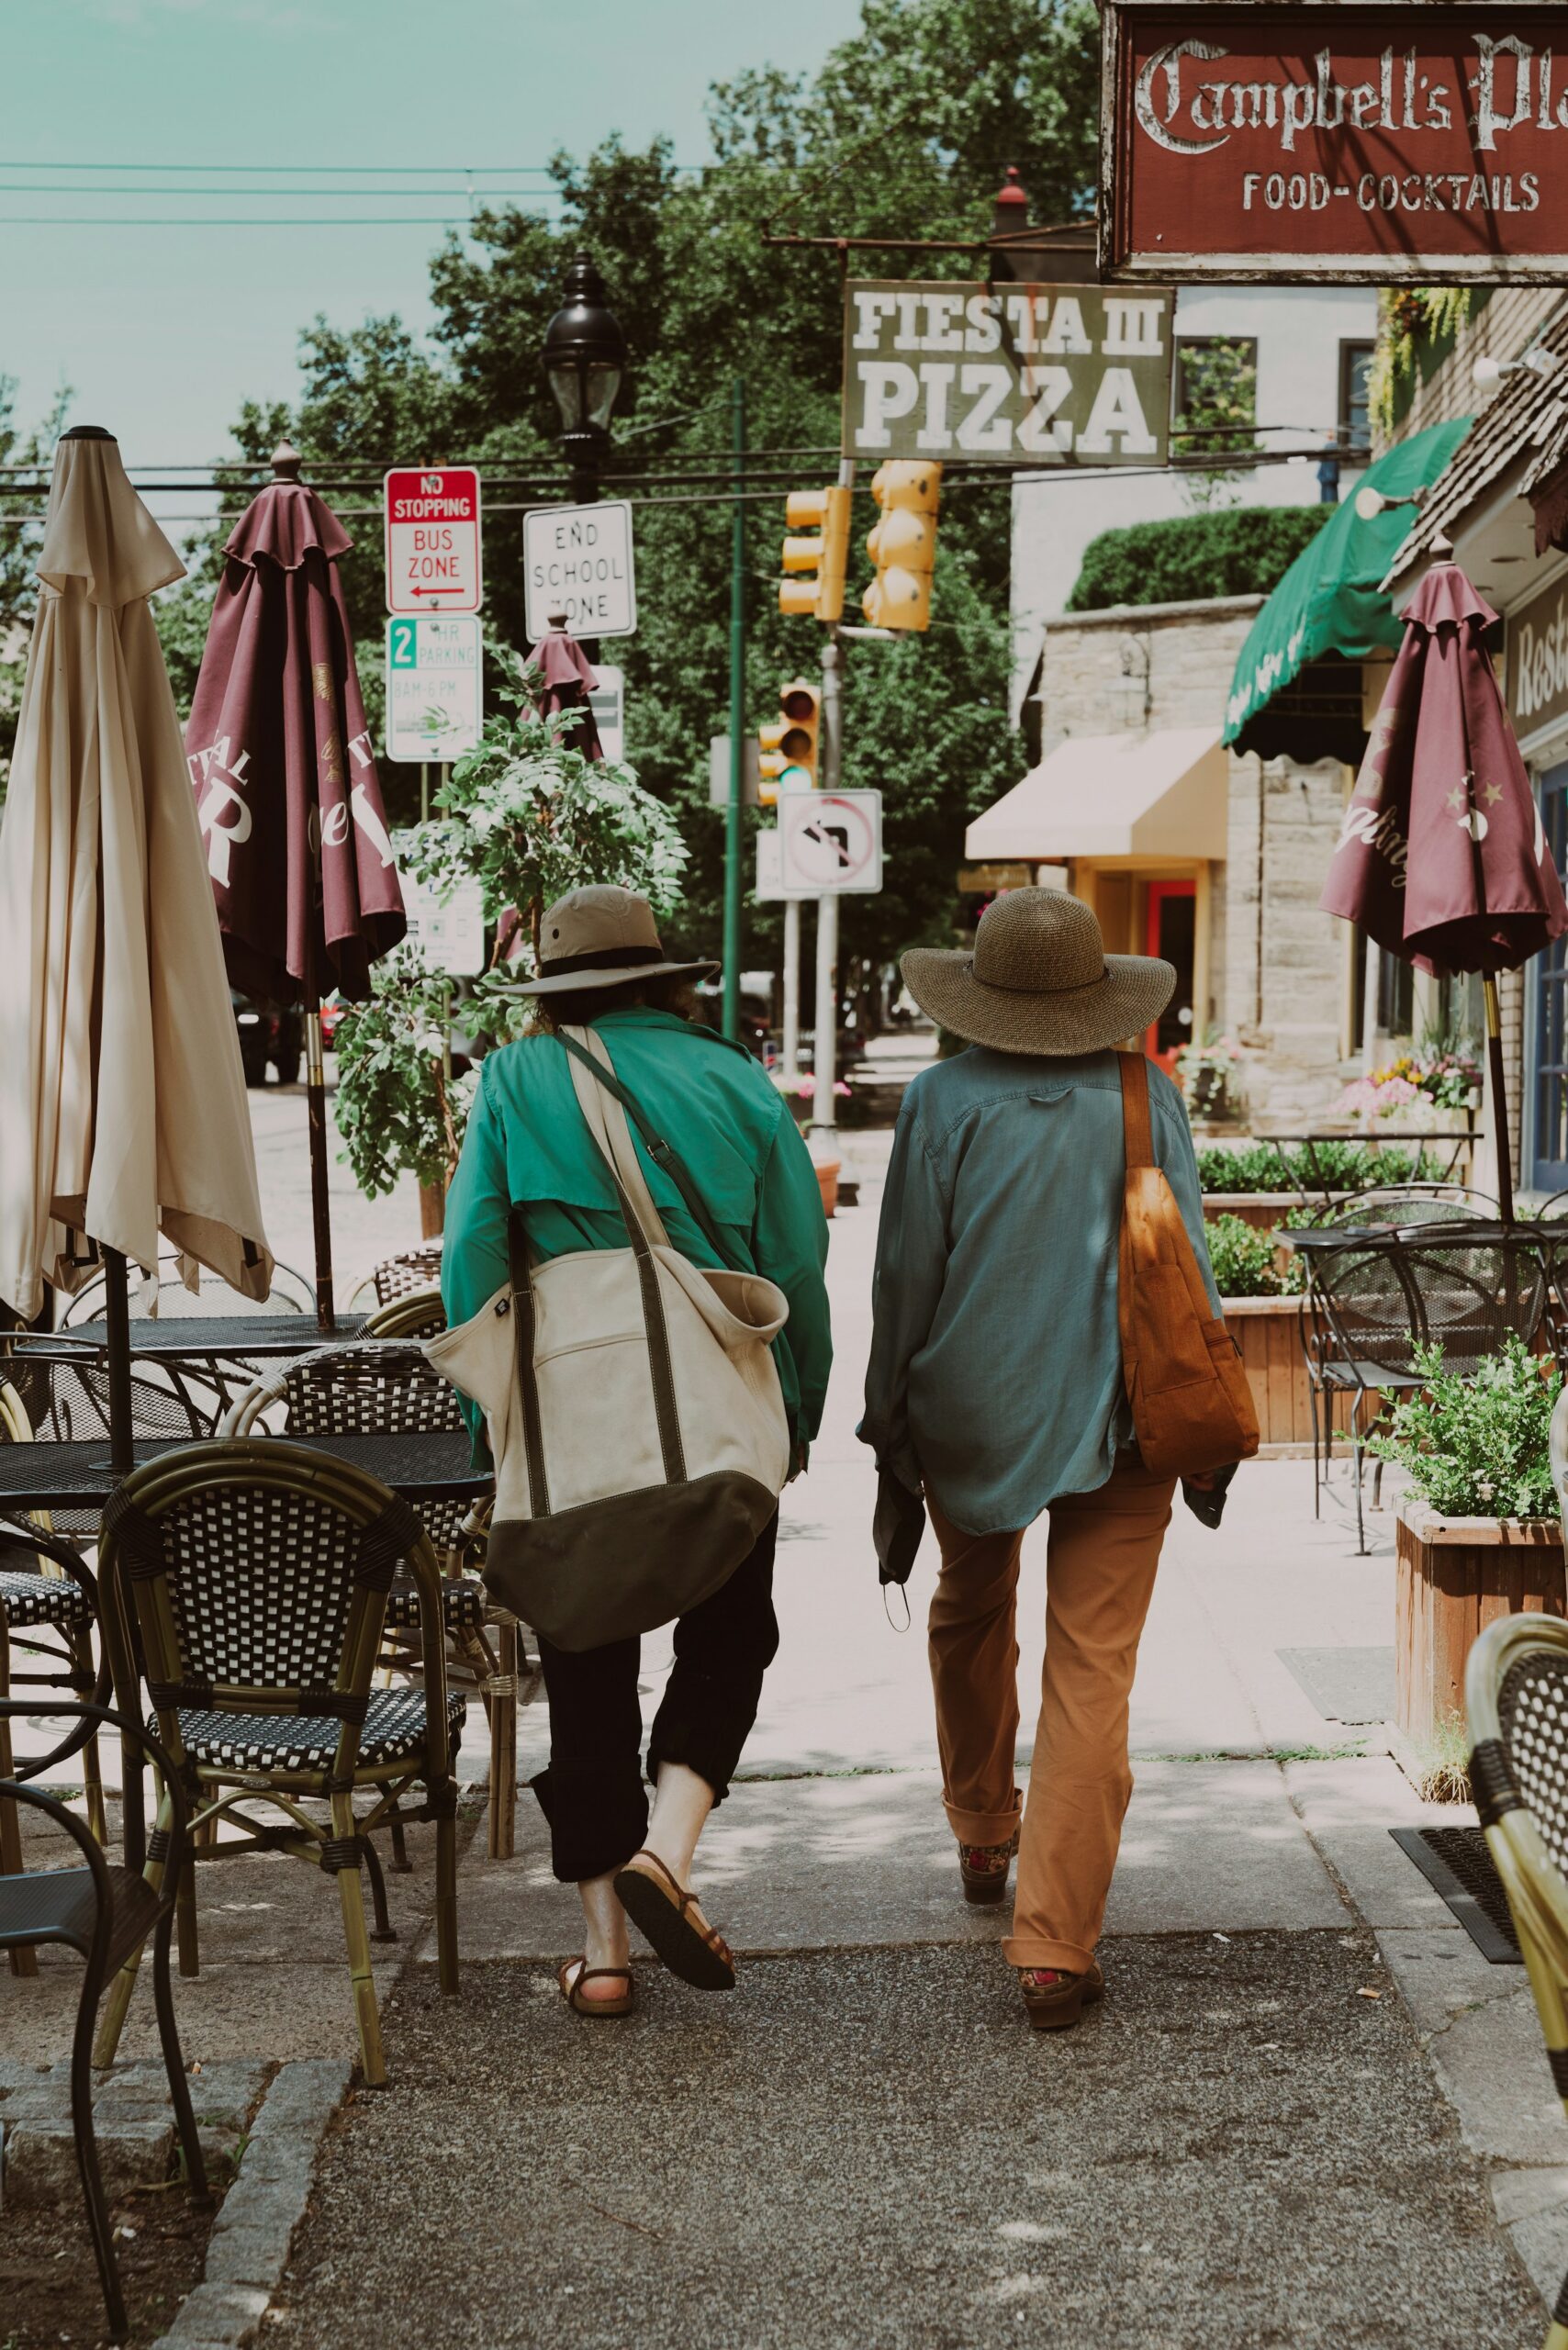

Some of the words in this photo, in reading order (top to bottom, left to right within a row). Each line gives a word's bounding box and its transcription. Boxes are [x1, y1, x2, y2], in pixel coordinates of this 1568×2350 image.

[1135, 38, 1452, 155] Campbell's
[1243, 172, 1540, 212] FOOD-COCKTAILS
[853, 291, 1092, 355] FIESTA
[1102, 298, 1165, 356] III
[855, 361, 1158, 454] PIZZA
[420, 475, 443, 495] NO
[394, 497, 471, 519] STOPPING
[414, 529, 453, 551] BUS
[555, 522, 599, 549] END
[408, 556, 460, 578] ZONE
[533, 557, 623, 588] SCHOOL
[395, 626, 411, 663] 2
[437, 624, 460, 642] HR
[419, 646, 475, 664] PARKING
